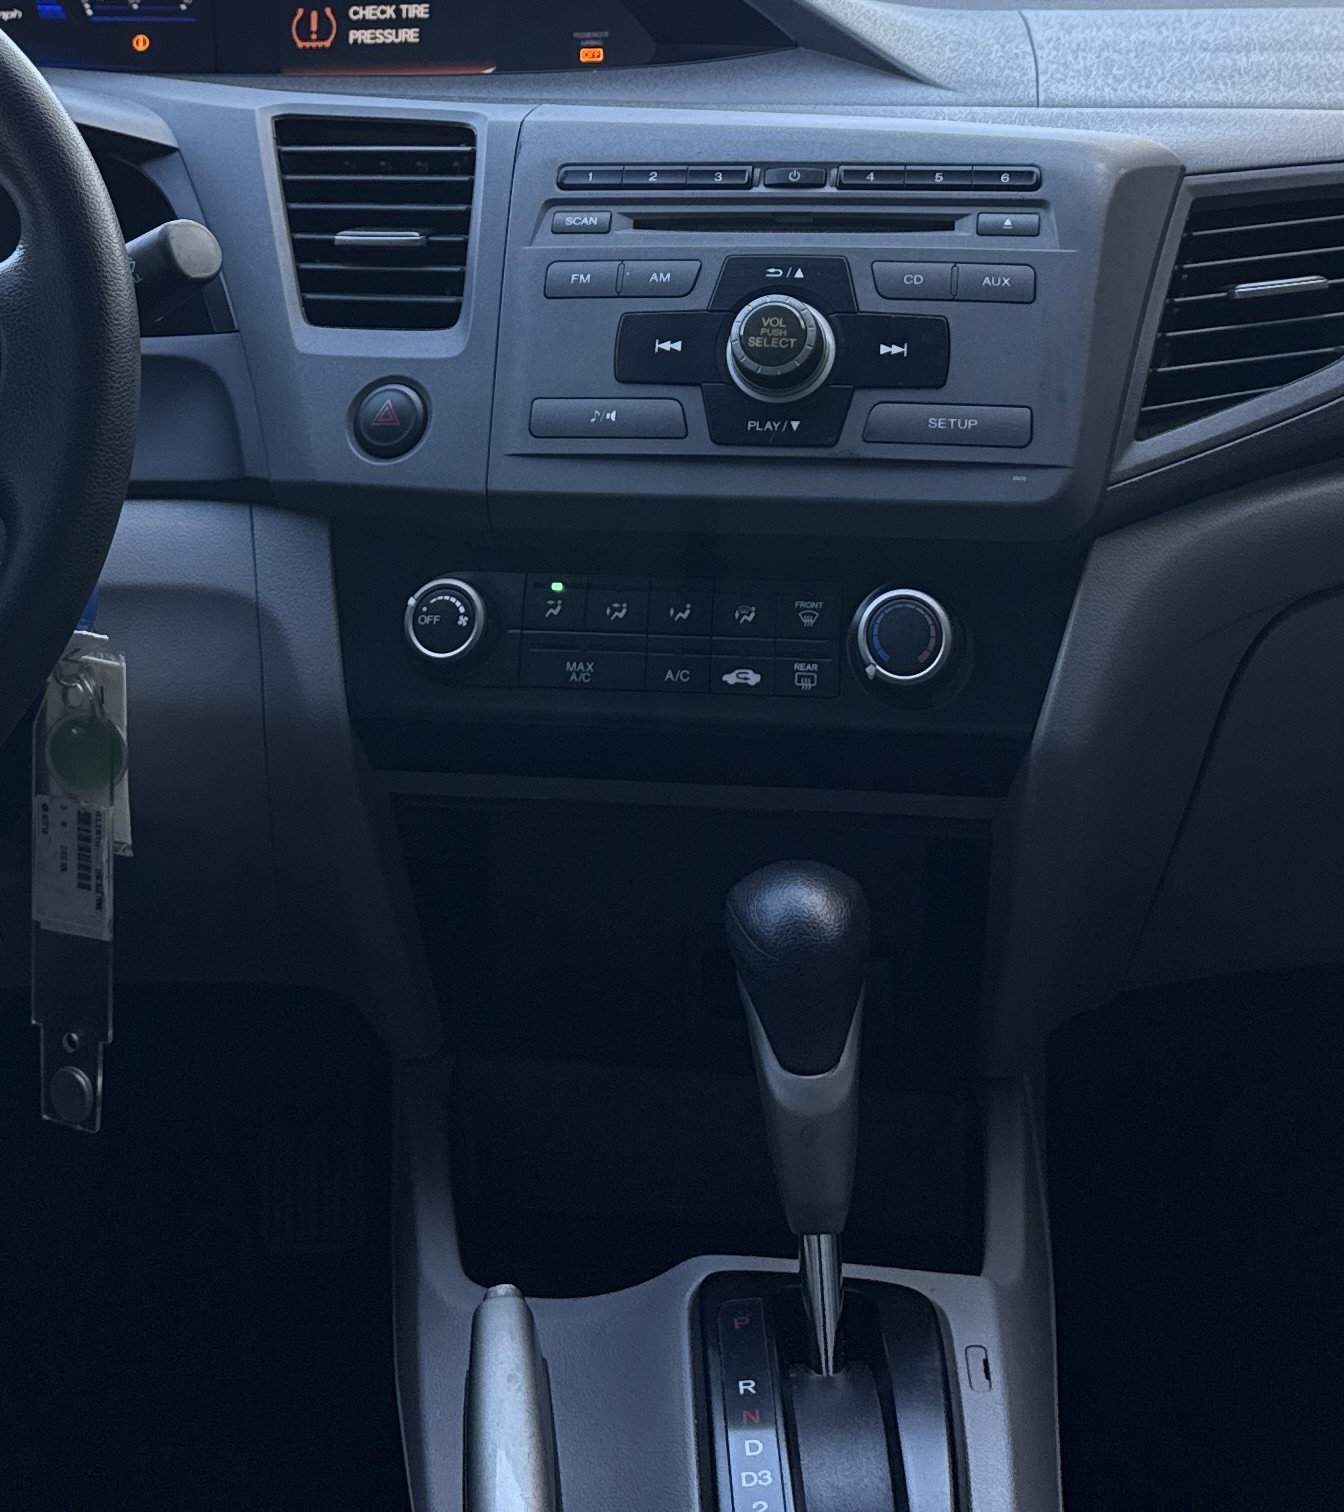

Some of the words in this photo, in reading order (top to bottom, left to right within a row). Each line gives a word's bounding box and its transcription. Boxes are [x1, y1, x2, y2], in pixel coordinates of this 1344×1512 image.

[347, 4, 397, 22] CHECK
[399, 3, 430, 20] TIRE
[347, 27, 421, 45] PRESSURE
[587, 172, 594, 182] 1
[648, 172, 658, 182] 2
[713, 172, 723, 182] 3
[865, 172, 875, 182] 4
[934, 172, 944, 182] 5
[1000, 173, 1010, 183] 6
[564, 215, 598, 227] SCAN
[570, 274, 592, 285] FM
[648, 273, 672, 284] AM
[903, 273, 925, 285] CD
[982, 276, 1012, 287] AUX
[761, 316, 787, 327] VOL
[759, 327, 788, 336] PUSH
[747, 336, 797, 348] SELECT
[927, 417, 979, 430] SETUP
[794, 600, 824, 609] FRONT
[417, 614, 441, 626] OFF
[565, 661, 595, 673] MAX
[793, 662, 819, 672] REAR
[568, 672, 592, 683] A/C
[664, 669, 691, 683] A/C
[733, 1315, 751, 1330] P
[737, 1378, 757, 1396] R
[741, 1408, 760, 1425] N
[743, 1438, 764, 1457] D
[740, 1469, 773, 1489] D3
